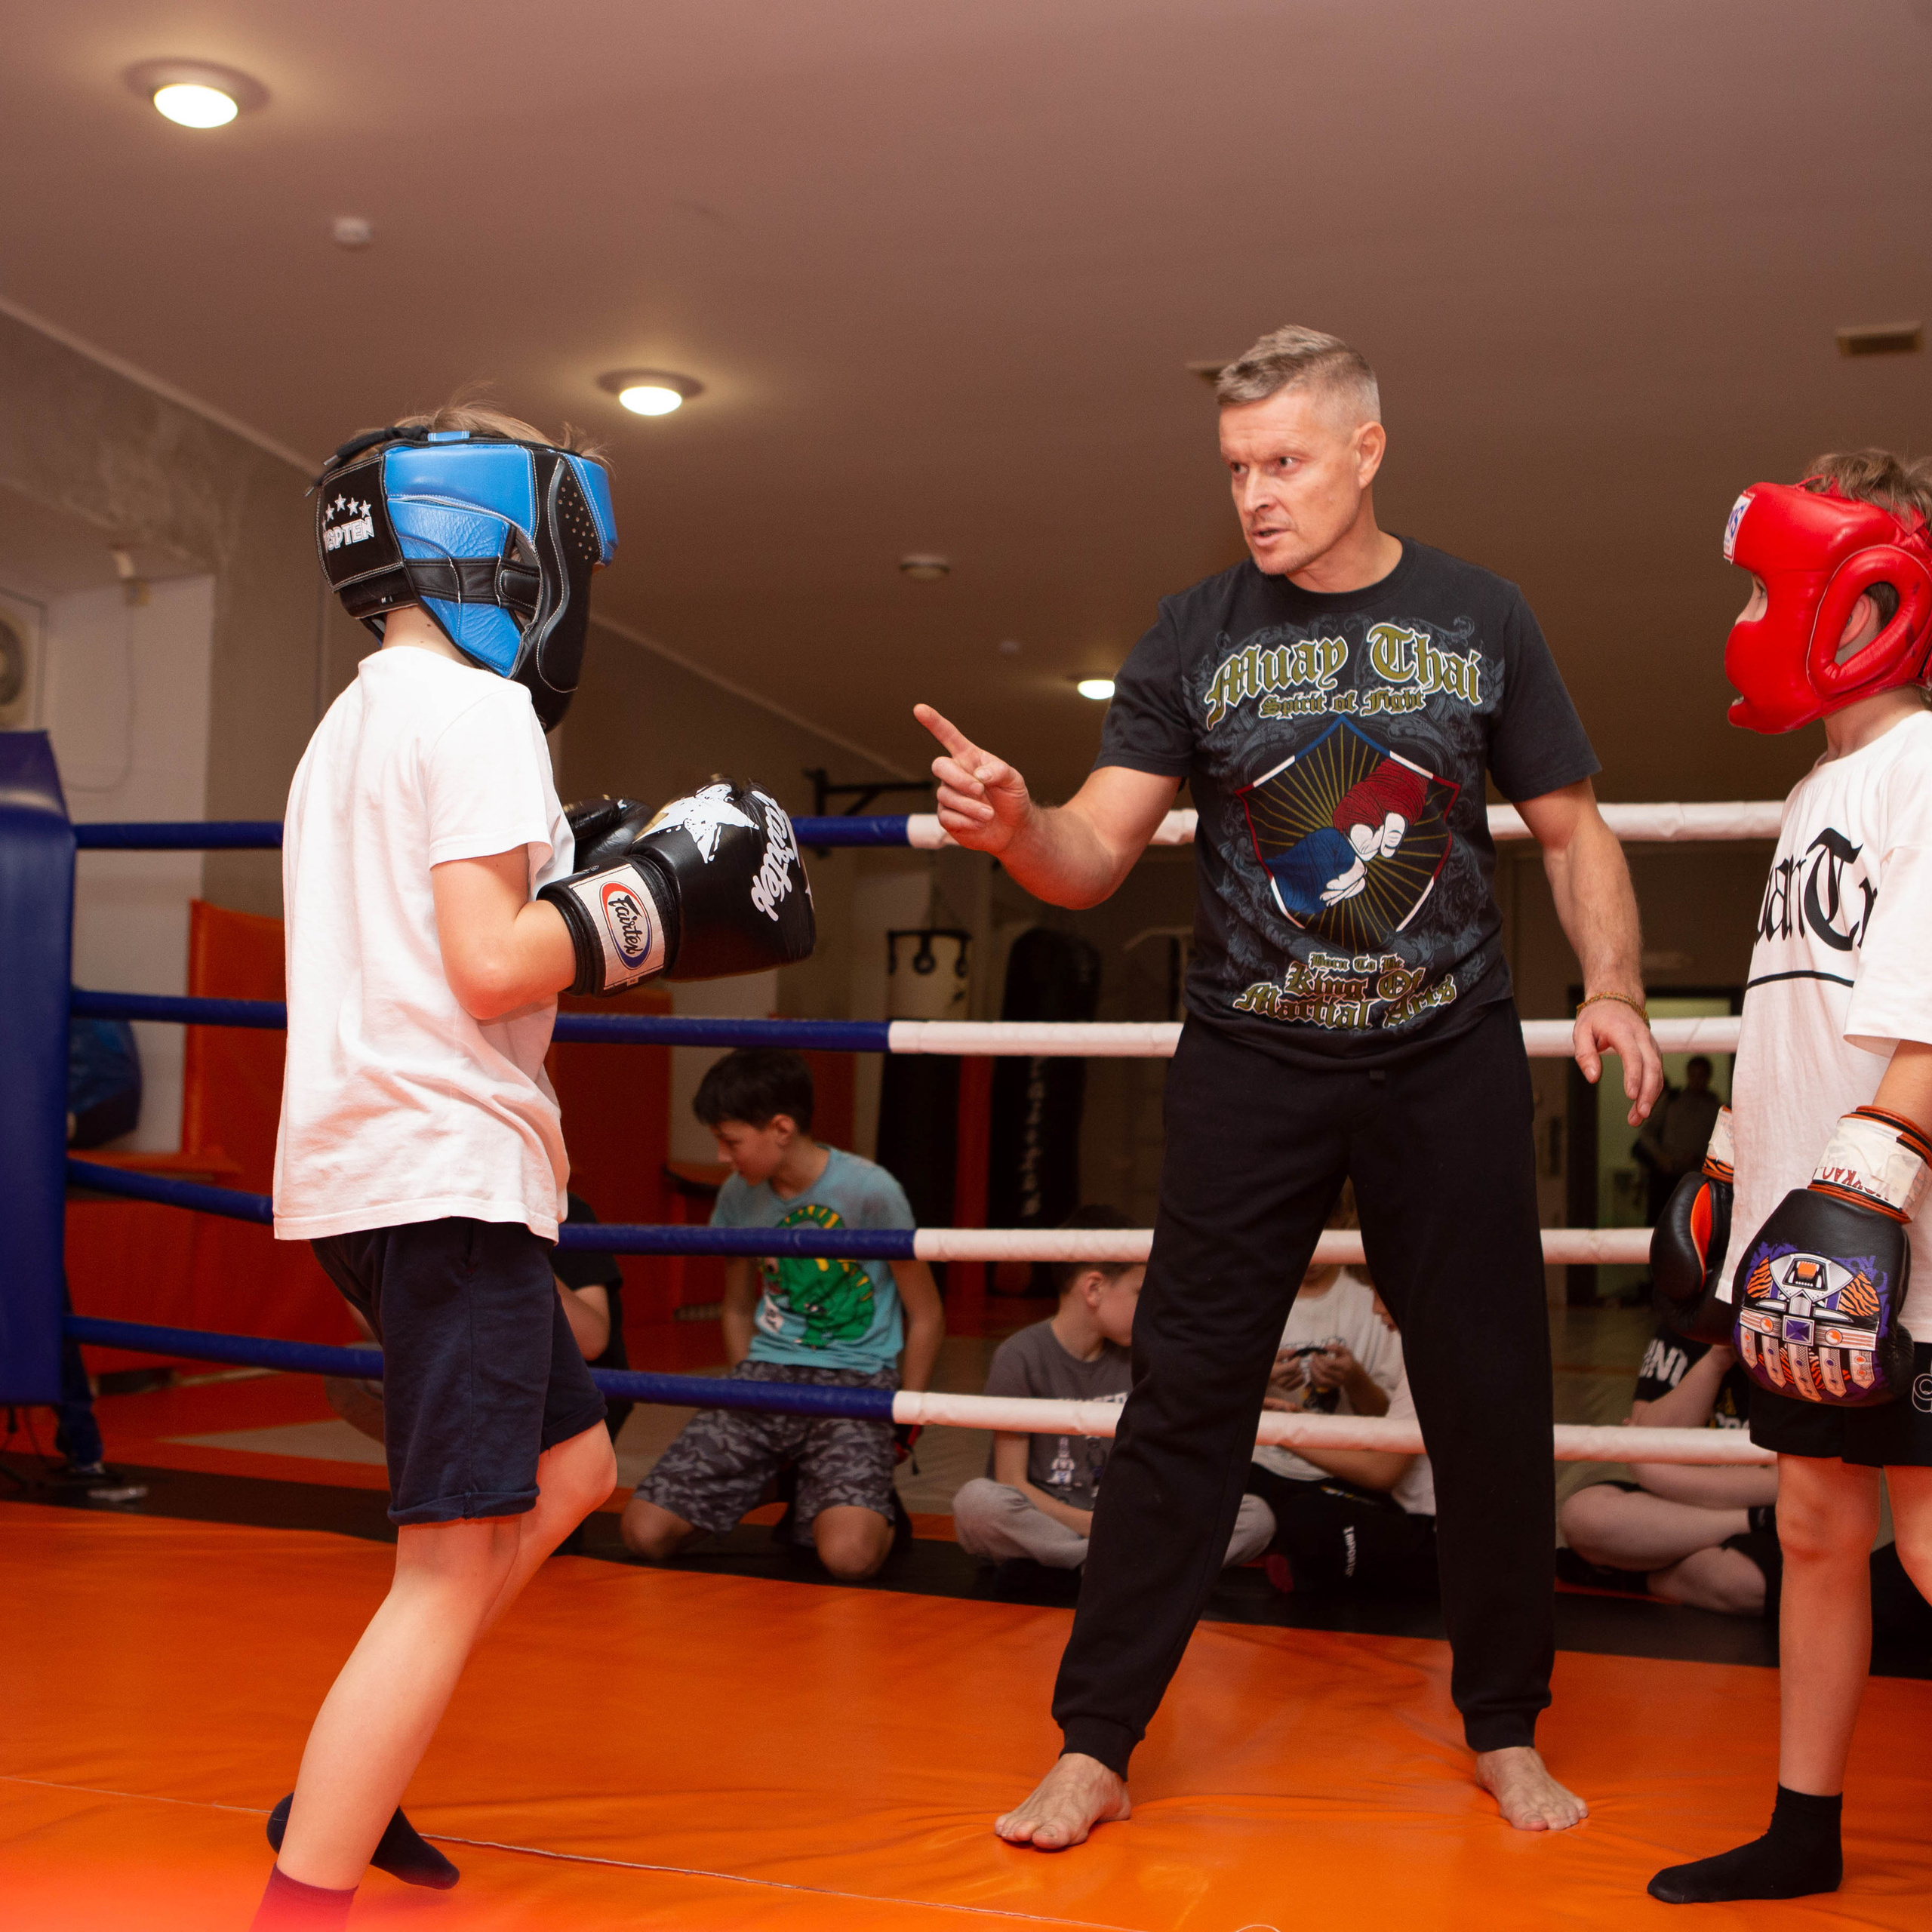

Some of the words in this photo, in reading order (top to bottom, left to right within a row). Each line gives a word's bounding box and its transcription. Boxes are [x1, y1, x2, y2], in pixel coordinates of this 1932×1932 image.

[1204, 636, 1349, 731] Muay
[1366, 622, 1483, 706] Thai
[1259, 690, 1327, 719] Spirit
[1330, 689, 1358, 713] of
[1360, 685, 1426, 716] Fight
[608, 895, 643, 955] Fairtex
[1284, 961, 1369, 1001] King
[1377, 967, 1426, 1001] Of
[1352, 953, 1377, 973] To
[1233, 982, 1380, 1030] Martial
